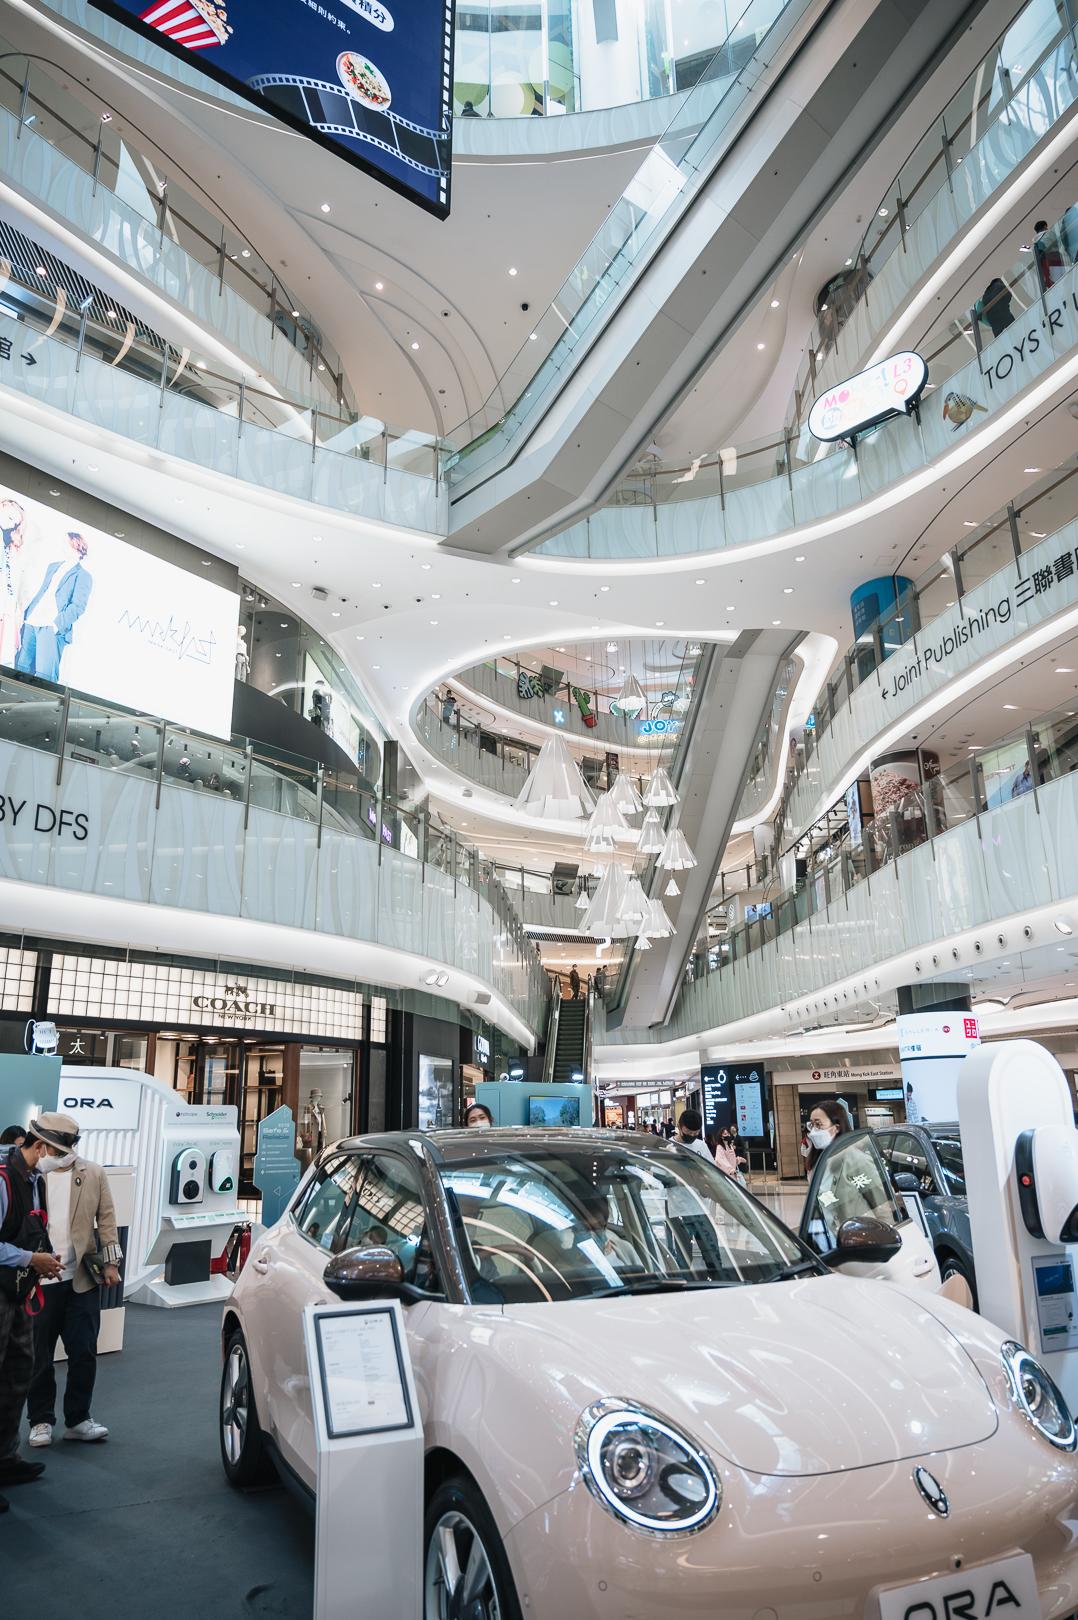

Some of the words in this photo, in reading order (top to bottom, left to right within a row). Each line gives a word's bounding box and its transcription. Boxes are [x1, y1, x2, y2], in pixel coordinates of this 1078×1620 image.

[892, 656, 922, 697] Joint
[923, 596, 1011, 671] Publishing
[34, 803, 89, 841] DFS
[192, 995, 277, 1016] COACH
[63, 1097, 114, 1109] ORA
